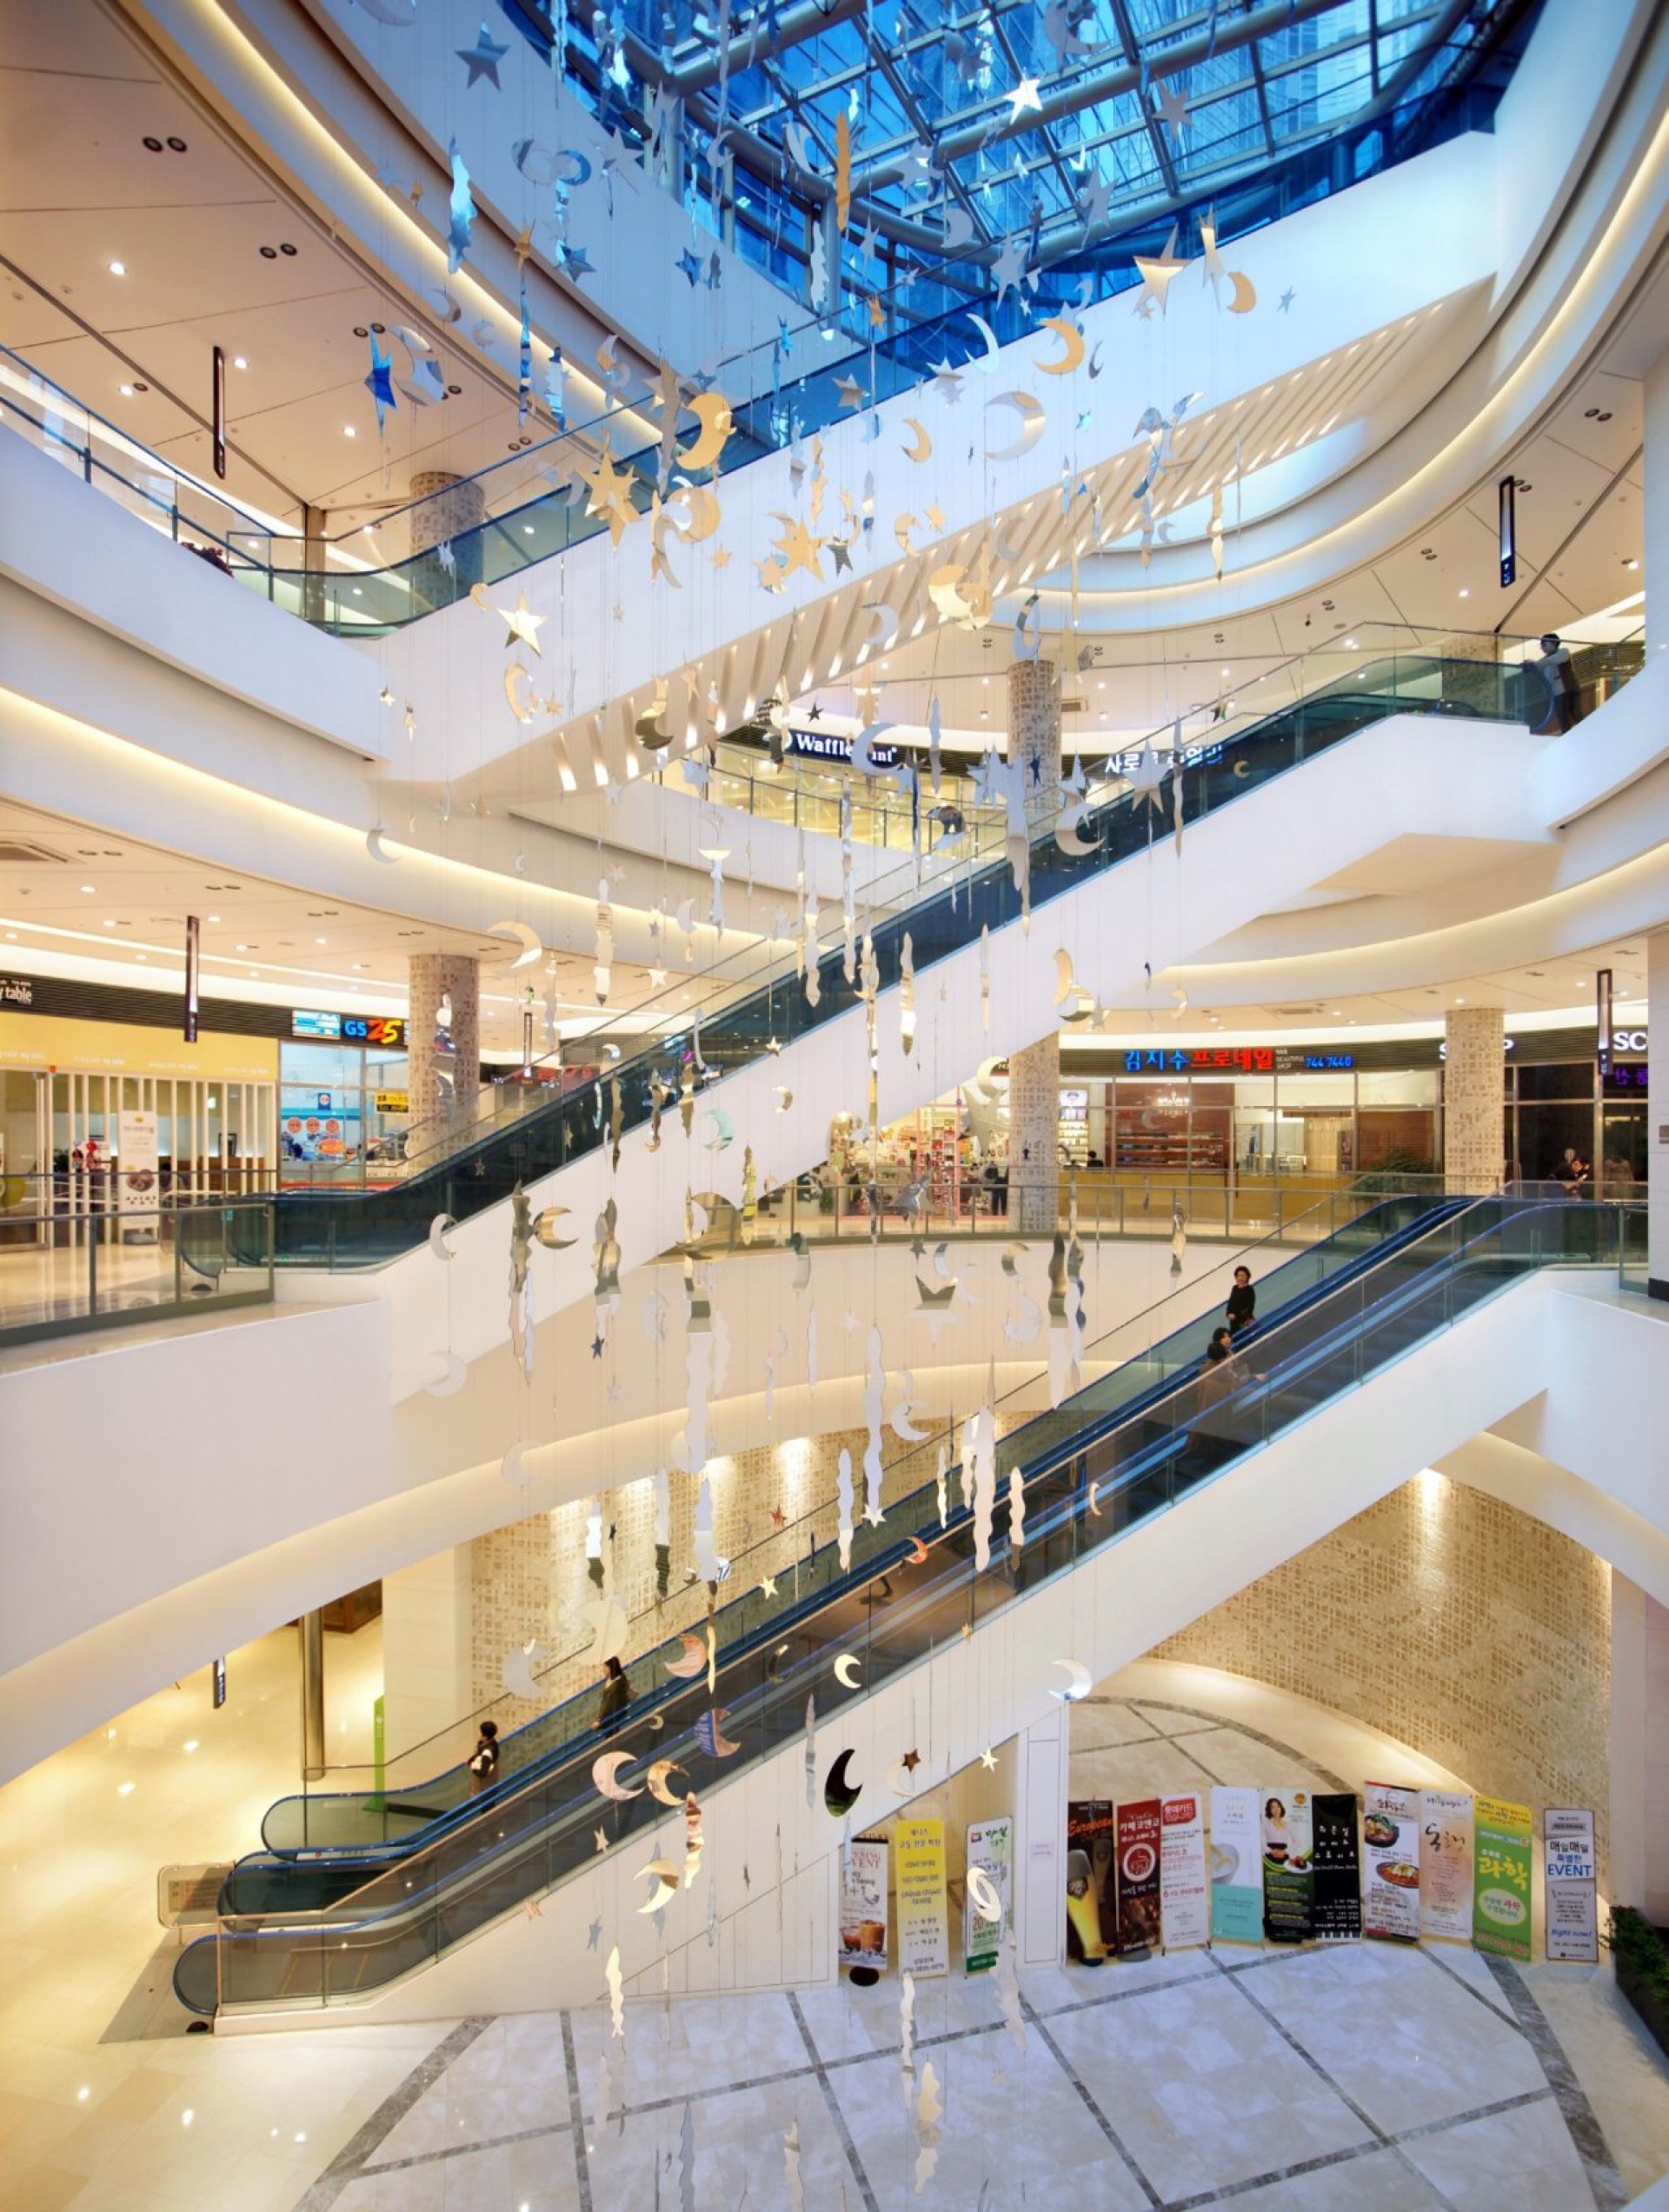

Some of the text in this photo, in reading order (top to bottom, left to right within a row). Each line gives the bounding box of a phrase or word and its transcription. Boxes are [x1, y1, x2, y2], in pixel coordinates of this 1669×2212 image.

[795, 733, 854, 756] Waffle
[5, 985, 32, 1002] table
[344, 1017, 402, 1043] GS25
[1191, 1048, 1273, 1070] 프로네일
[1478, 1856, 1527, 1891] 과학
[1547, 1864, 1592, 1876] EVENT
